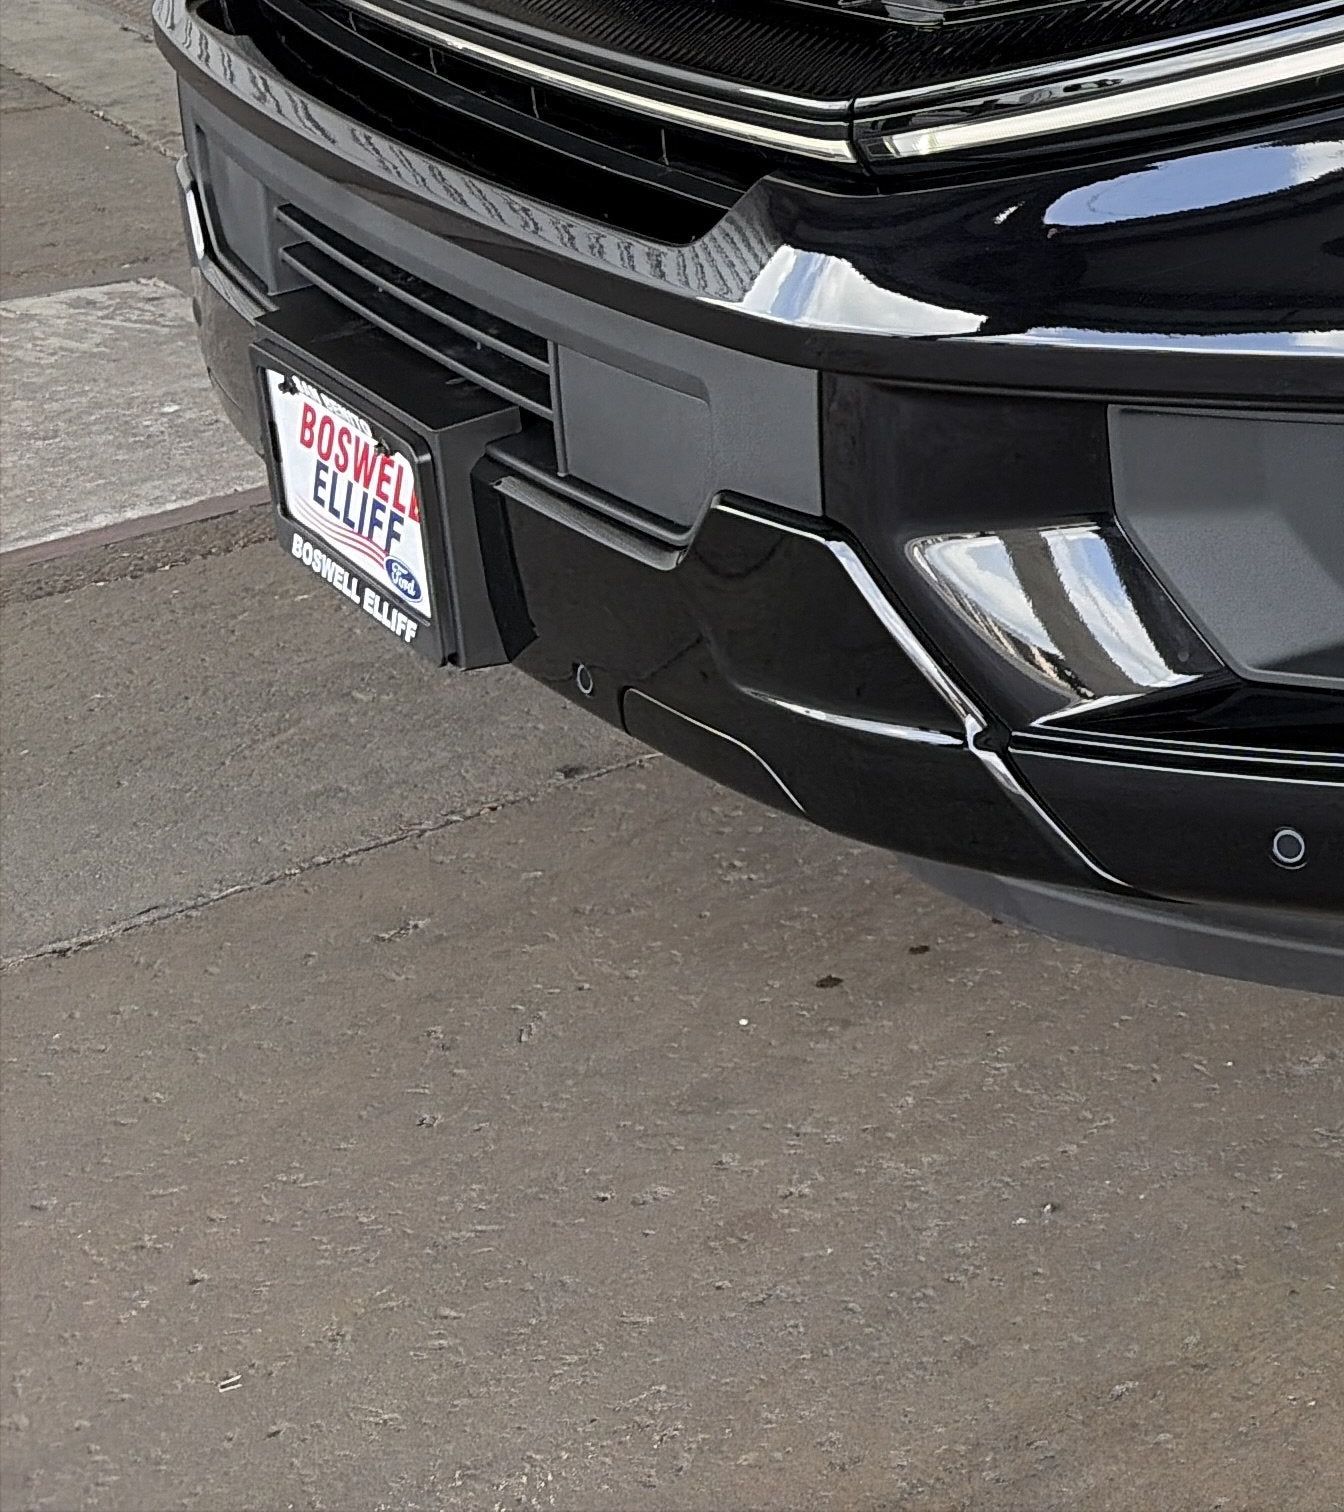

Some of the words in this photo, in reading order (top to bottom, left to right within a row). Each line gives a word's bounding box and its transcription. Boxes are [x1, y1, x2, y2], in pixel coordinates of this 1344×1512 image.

[312, 460, 405, 555] ELLIFF
[291, 533, 361, 606] BOSWELL
[362, 590, 418, 643] ELLIFF
